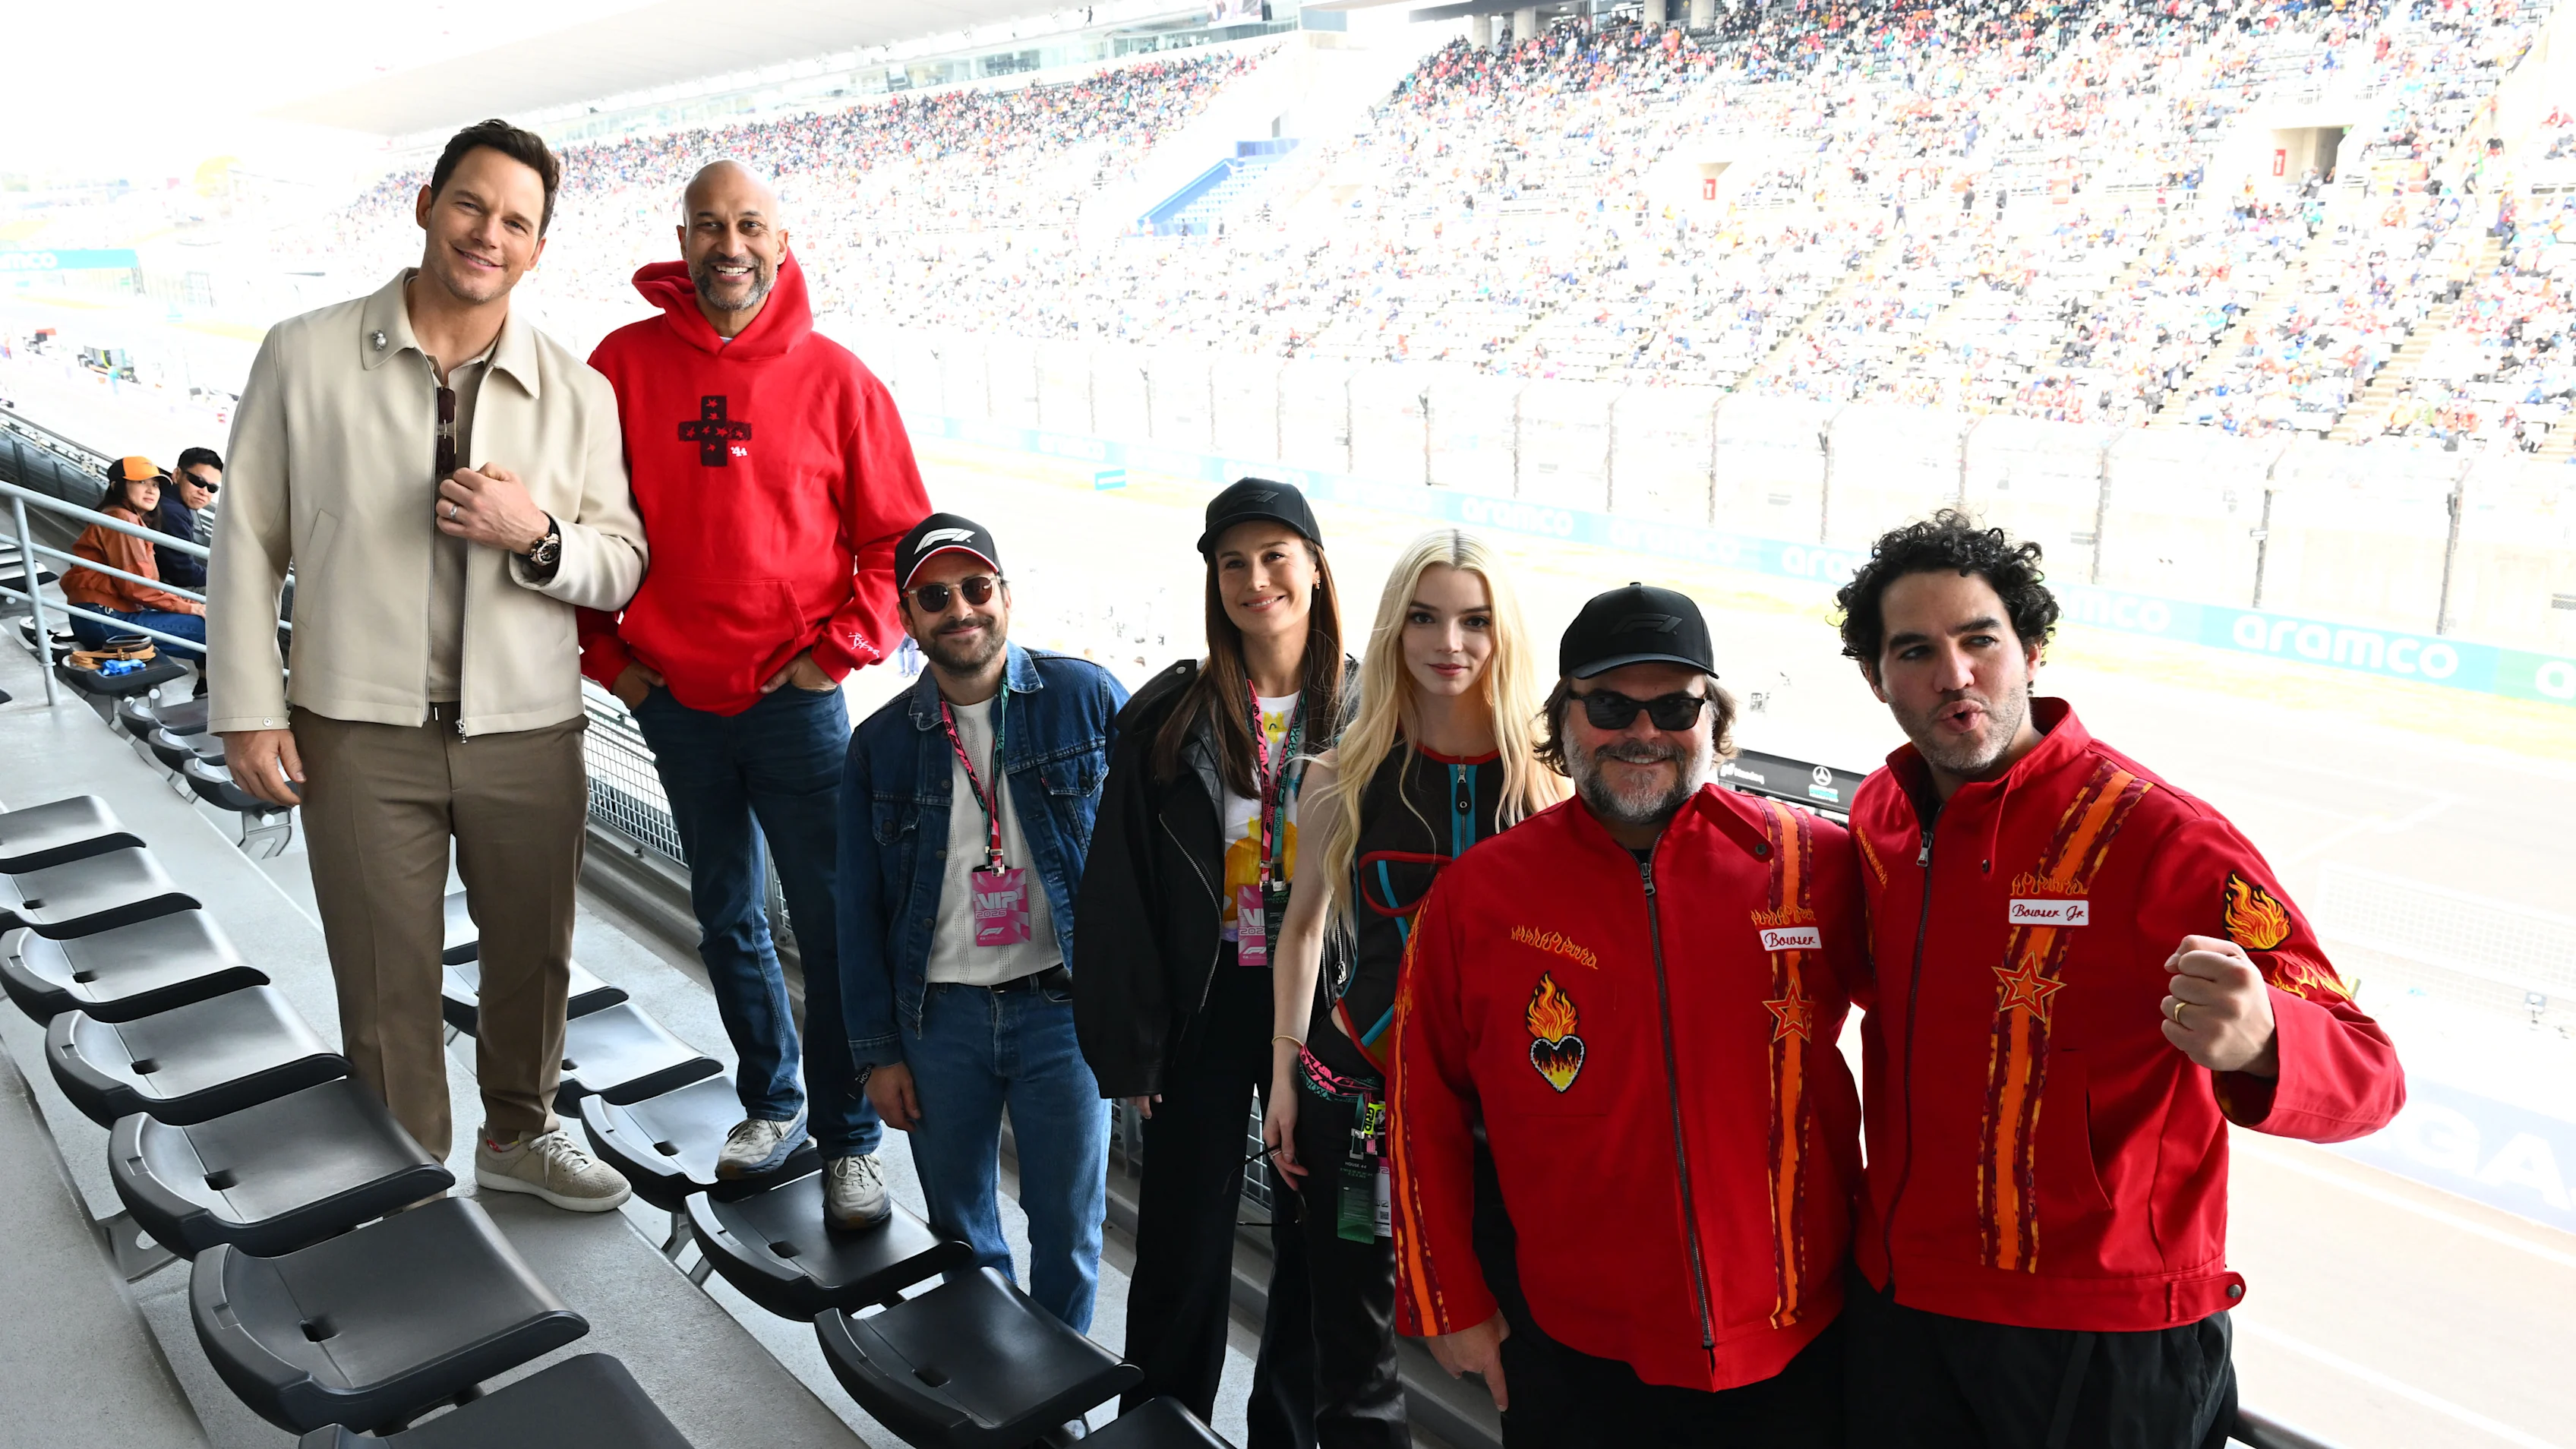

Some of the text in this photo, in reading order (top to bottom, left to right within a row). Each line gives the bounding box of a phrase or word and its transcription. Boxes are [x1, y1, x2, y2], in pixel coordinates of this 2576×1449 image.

[1462, 497, 1574, 536] aramco
[914, 528, 976, 555] F1
[1609, 521, 1741, 562] aramco
[2233, 613, 2459, 679] aramco
[977, 891, 1018, 910] VIP
[976, 910, 1007, 920] 2026
[1242, 908, 1264, 926] VI
[2012, 904, 2085, 920] Bowser Jr
[1239, 927, 1265, 936] 202
[1764, 932, 1815, 948] Bowser
[1365, 1106, 1375, 1132] GRID
